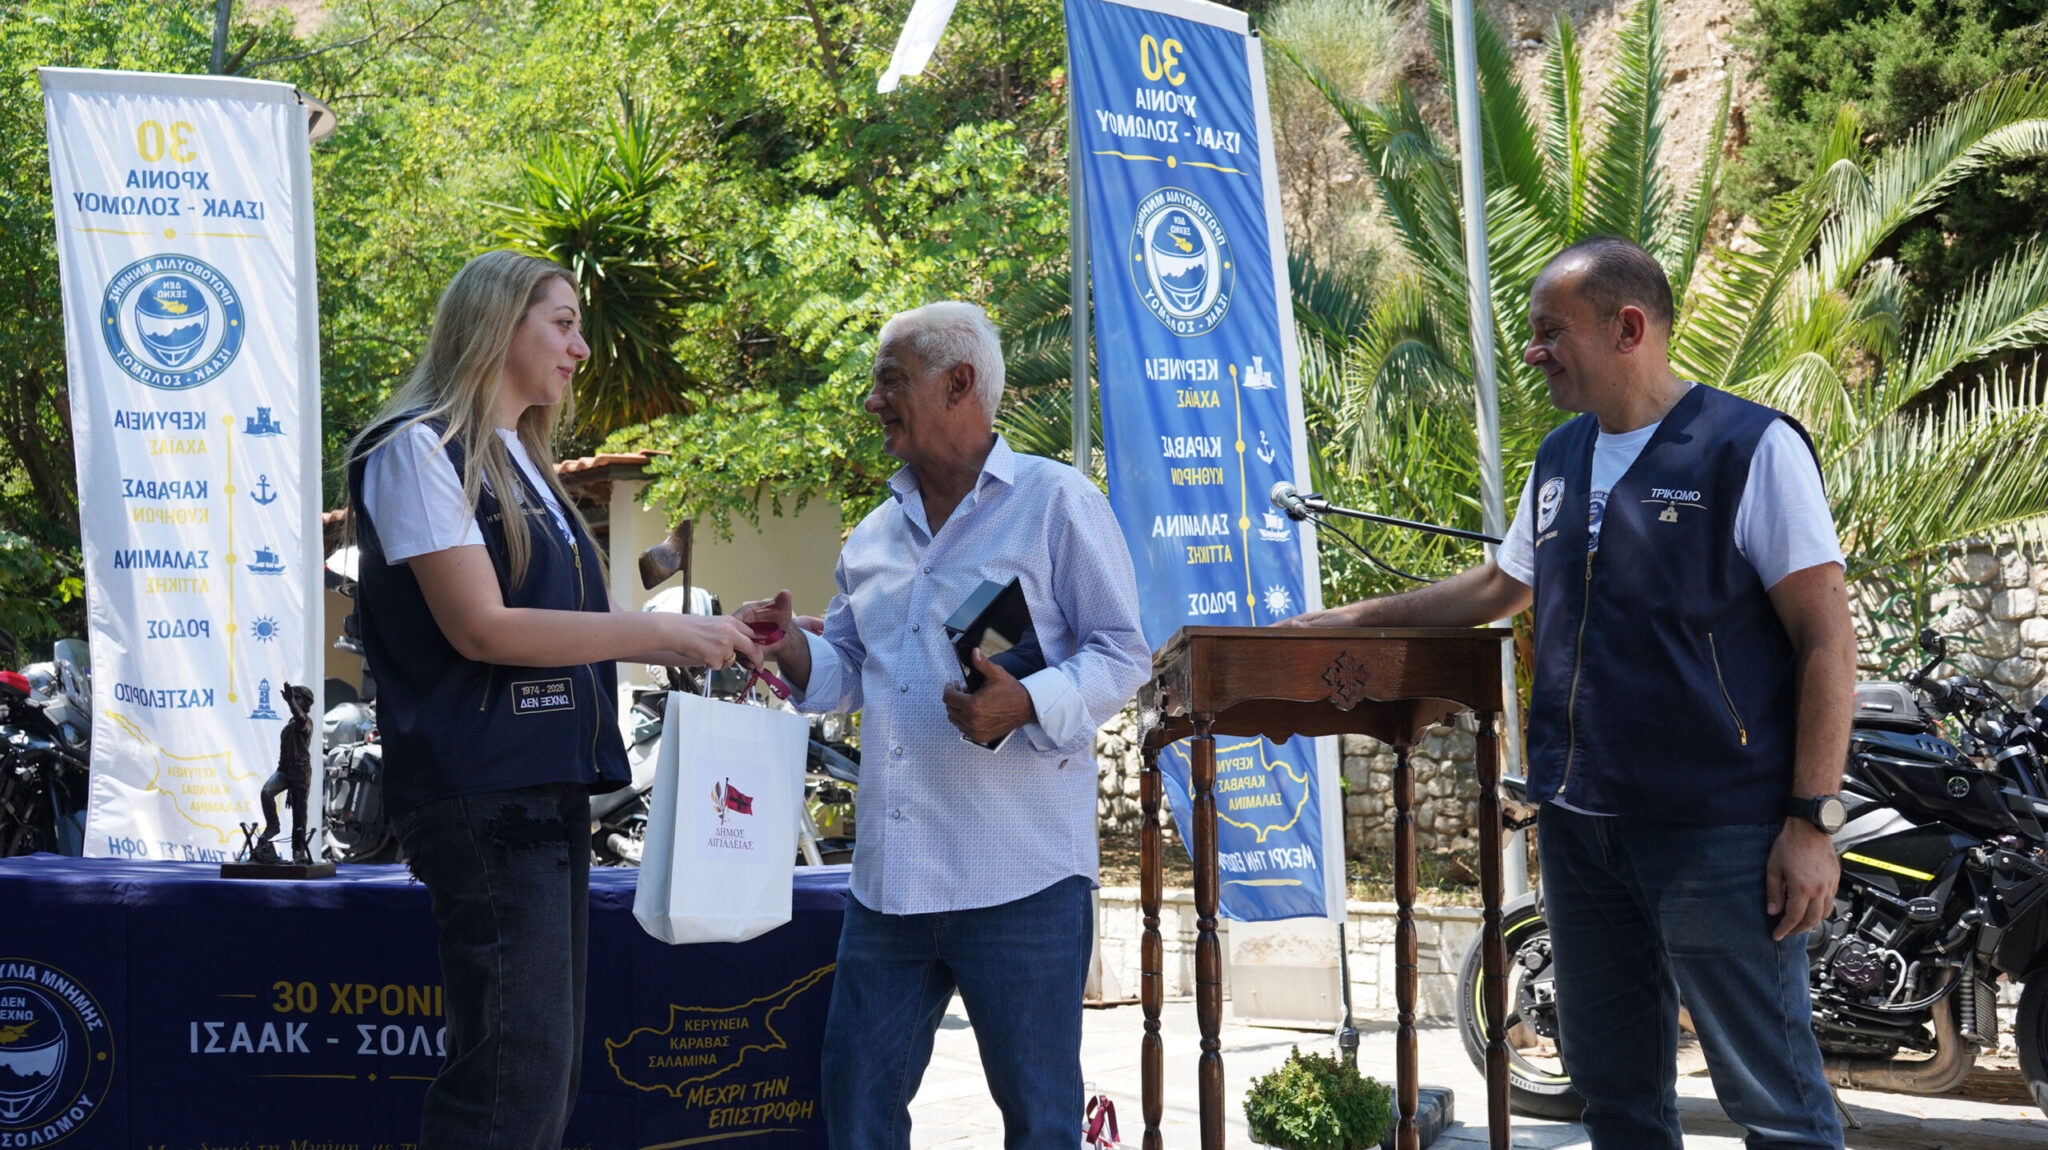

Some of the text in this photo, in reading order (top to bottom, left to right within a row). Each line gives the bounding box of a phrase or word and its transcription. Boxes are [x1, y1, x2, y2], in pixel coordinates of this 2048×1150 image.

[1651, 488, 1701, 501] ΤΡΙΚΩΜΟ
[521, 686, 540, 695] 1974
[520, 694, 569, 708] ΔΕΝ ΞΕΧΝΩ
[715, 827, 745, 838] ΔΗΜΟΣ
[40, 969, 103, 1032] ΜΝΗΜΗΣ
[271, 981, 442, 1016] 30 ΧΡΟΝΙ
[0, 1009, 34, 1021] ΕΧΝΩ
[684, 1016, 749, 1032] ΚΕΡΥΝΕΙΑ
[190, 1021, 310, 1054] ΙΣΑΑΚ
[670, 1036, 730, 1050] ΚΑΡΑΒΑΣ
[648, 1053, 717, 1068] ΣΑΛΑΜΙΝΑ
[685, 1075, 790, 1110] ΜΕΧΡΙ ΤΗΝ
[1, 1093, 95, 1148] ΣΟΛΩΜΟΥ
[708, 1099, 814, 1128] ΕΠΙΣΤΡΟΦΗ
